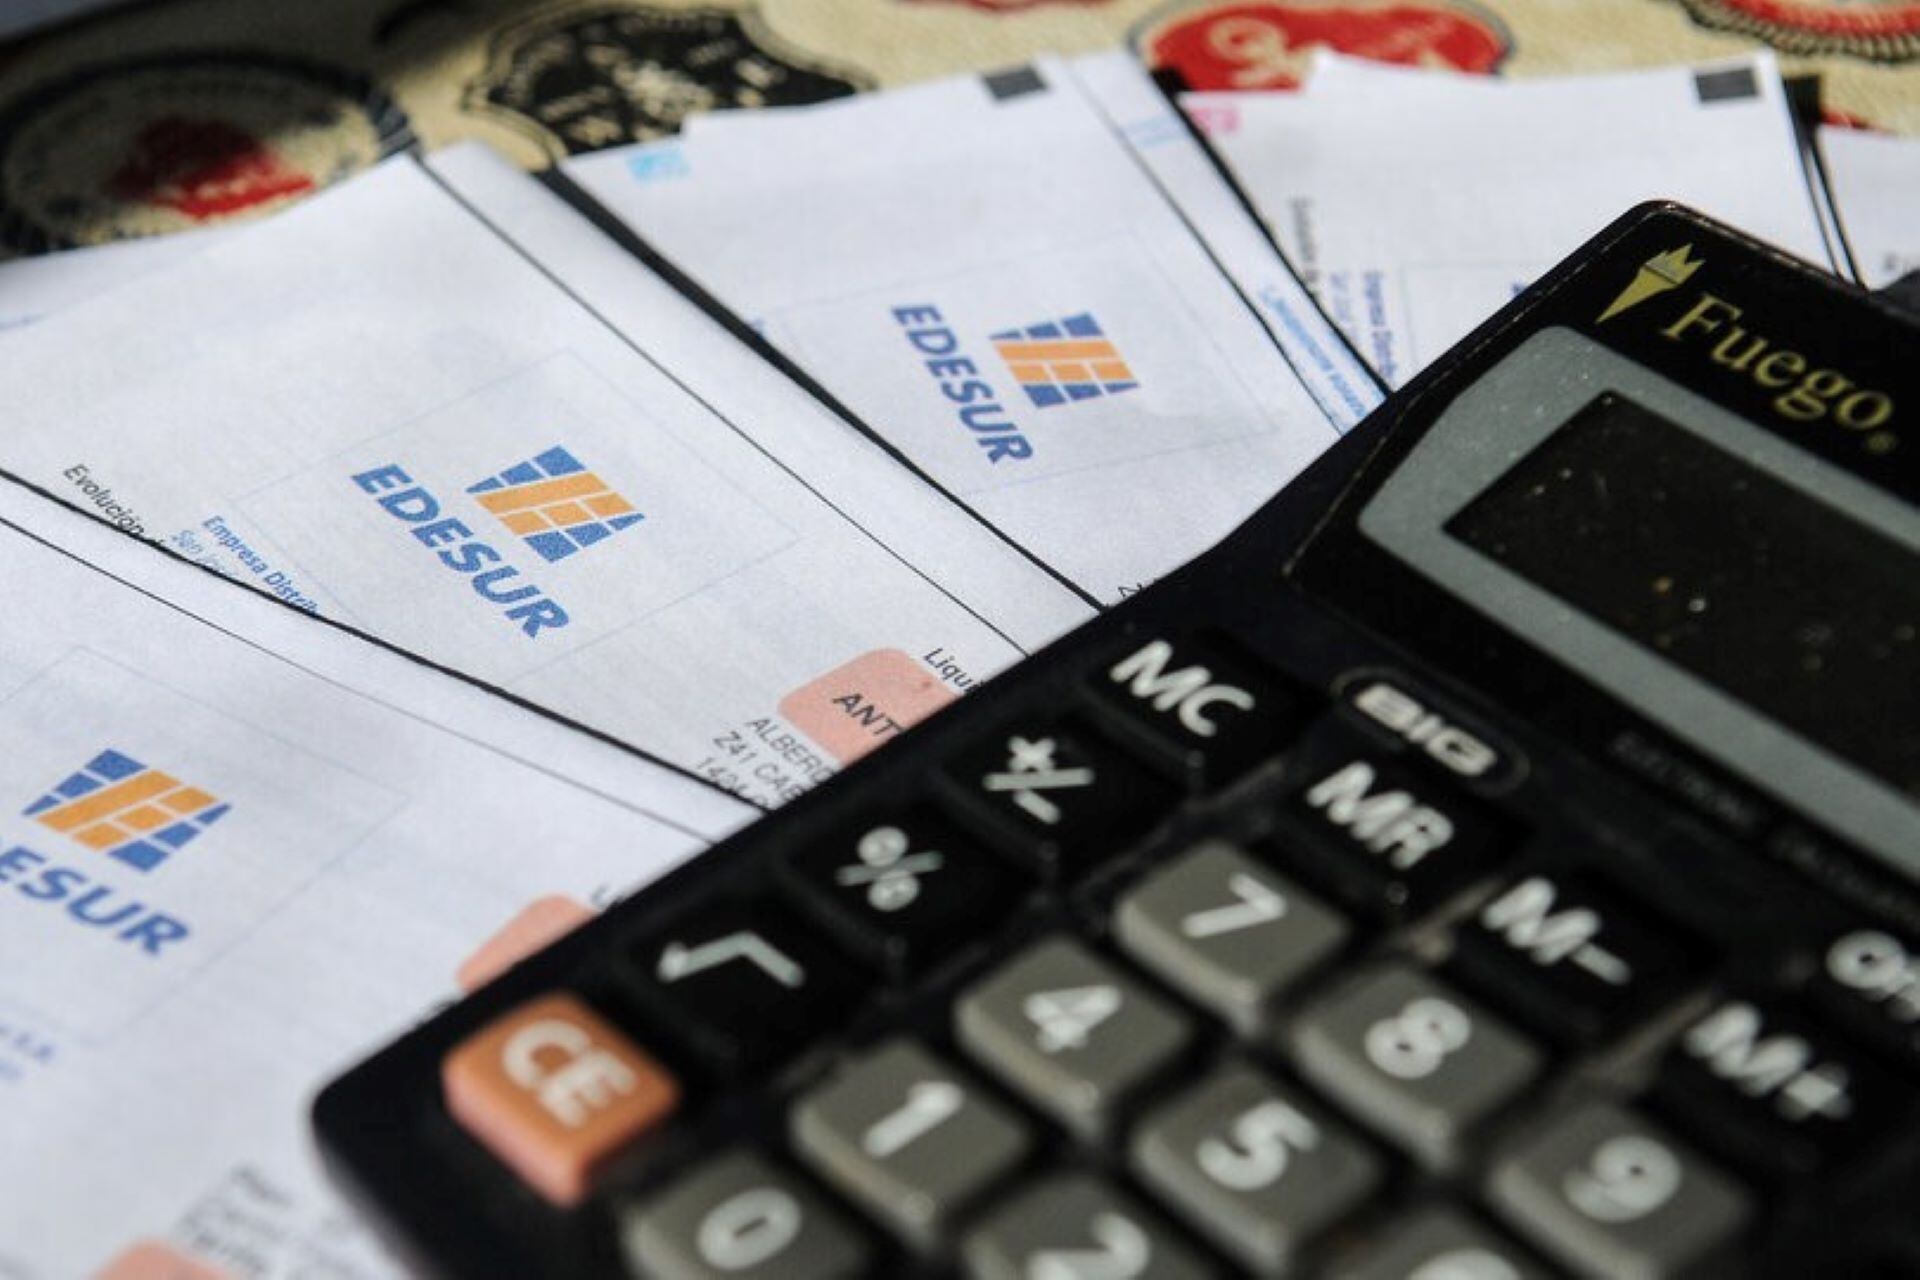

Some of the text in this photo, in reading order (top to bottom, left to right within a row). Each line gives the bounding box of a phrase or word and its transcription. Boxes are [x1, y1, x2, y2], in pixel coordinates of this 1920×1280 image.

[891, 303, 1034, 464] EDESUR
[203, 515, 268, 574] Empresa
[351, 463, 570, 639] EDESUR
[833, 692, 907, 738] ANT
[1110, 640, 1256, 737] MC
[1353, 683, 1500, 777] BIG
[1307, 760, 1455, 868] MR
[1181, 872, 1287, 938] 7
[1024, 985, 1123, 1053] 4
[1364, 997, 1473, 1080] 8
[1685, 1003, 1852, 1122] M+
[503, 1018, 638, 1130] CE
[862, 1081, 965, 1158] 1
[1198, 1100, 1321, 1191] 5
[1563, 1134, 1683, 1225] 9
[696, 1188, 802, 1270] 0
